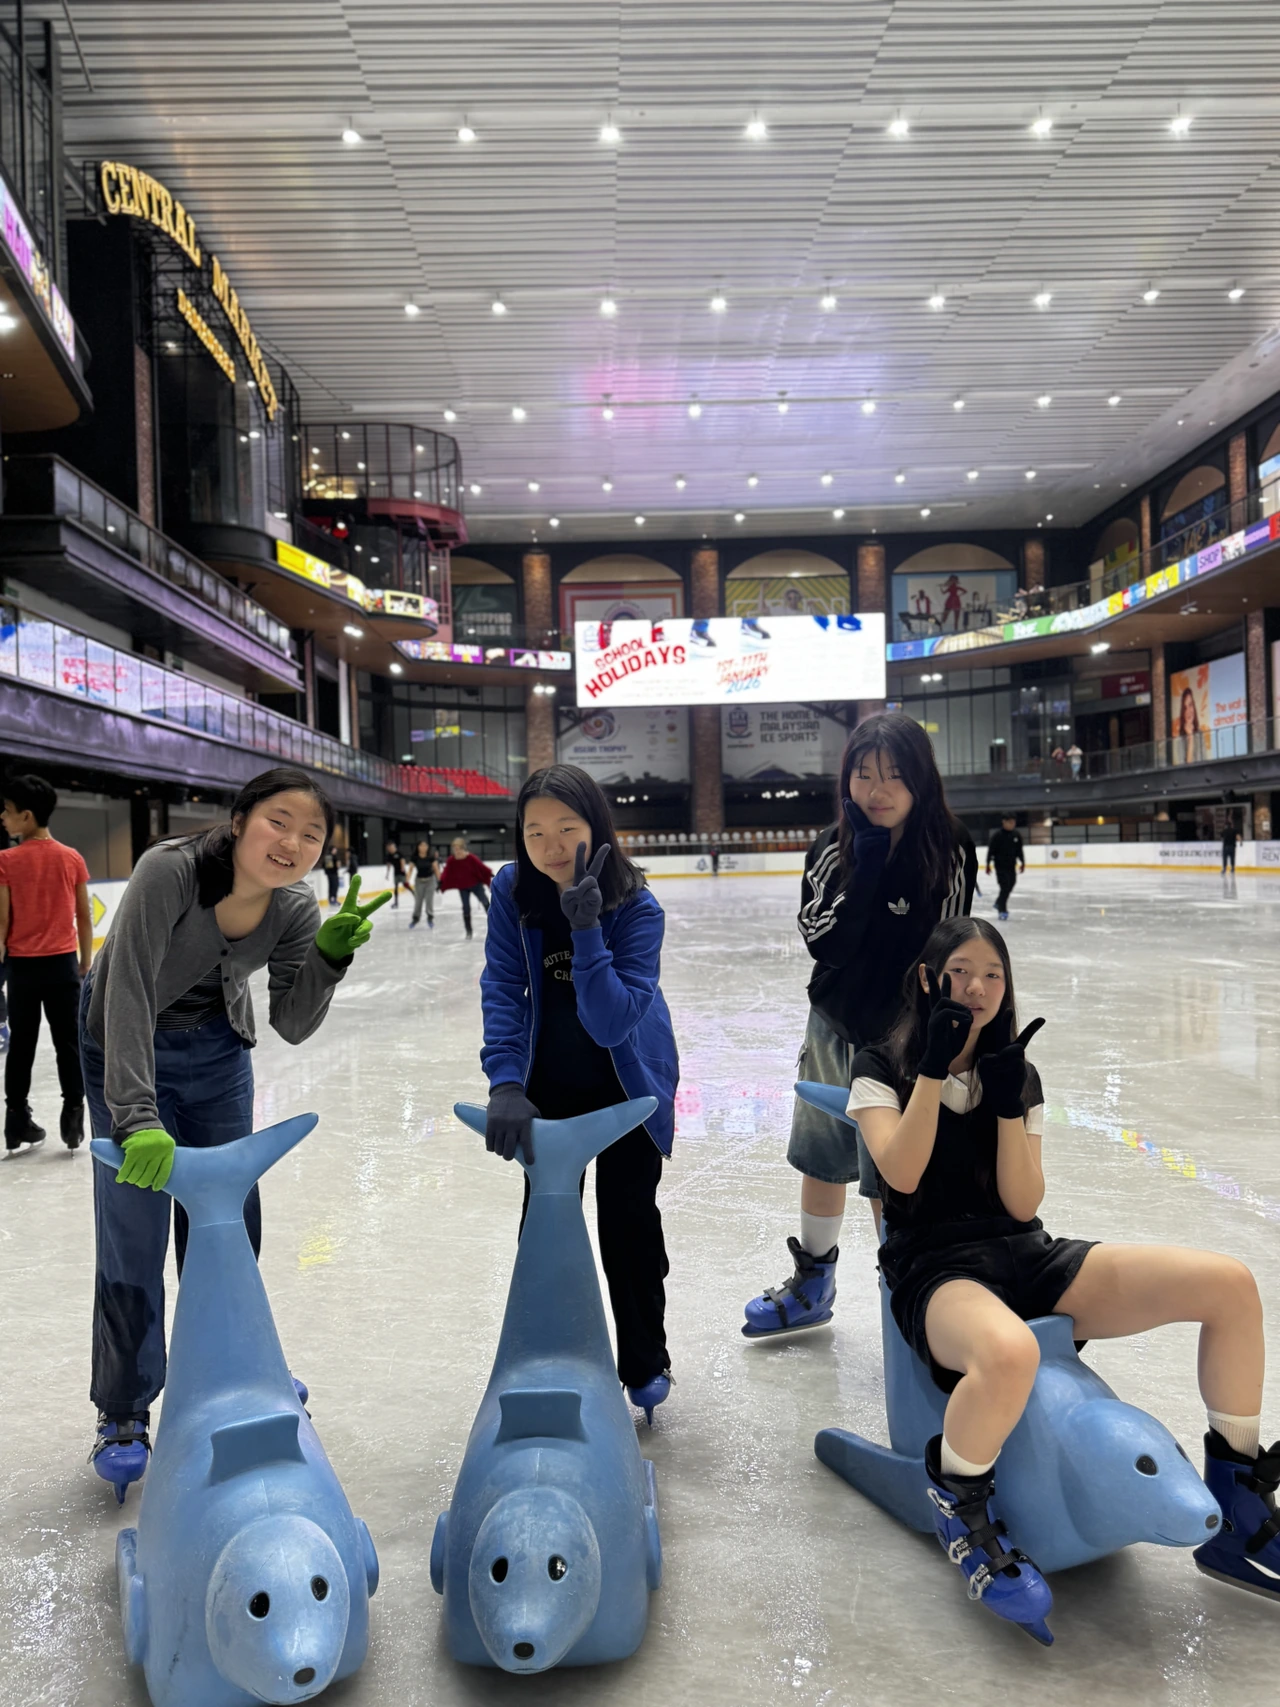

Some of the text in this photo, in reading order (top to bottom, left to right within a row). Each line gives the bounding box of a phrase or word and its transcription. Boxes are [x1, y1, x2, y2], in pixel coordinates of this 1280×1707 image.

[101, 160, 201, 268] CENTRAL
[462, 612, 512, 624] SHOPPING
[463, 624, 512, 636] PRADISE
[595, 638, 645, 670] SCHOOL
[585, 645, 686, 698] HOLIDAYS
[760, 711, 778, 720] THE
[782, 710, 811, 719] HOME
[760, 721, 820, 731] MALAYSIAN
[760, 732, 819, 743] ICE SPORTS
